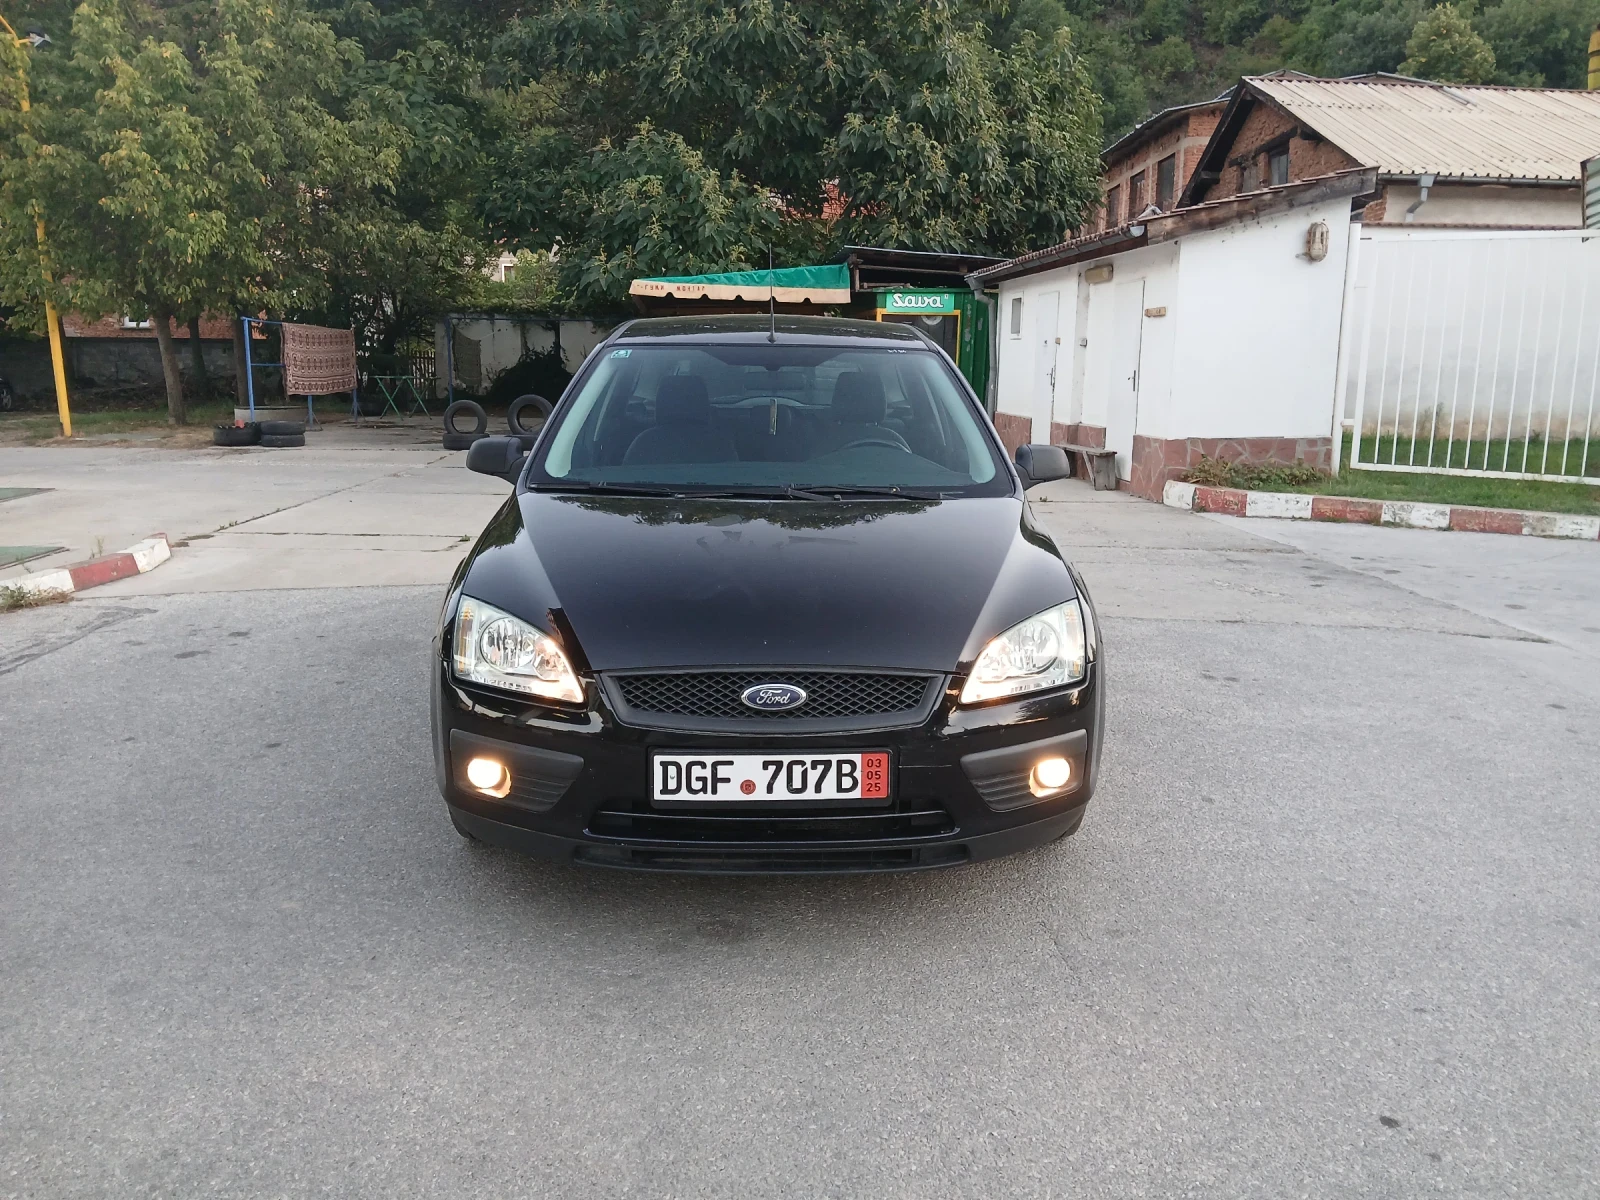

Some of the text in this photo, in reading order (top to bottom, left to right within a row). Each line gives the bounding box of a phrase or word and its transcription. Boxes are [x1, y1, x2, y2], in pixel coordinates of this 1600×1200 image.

[892, 293, 944, 308] Sava
[756, 689, 791, 704] Ford
[866, 758, 882, 768] 03
[659, 759, 859, 795] DGF 707B
[866, 770, 882, 780] 05
[866, 782, 881, 792] 25
